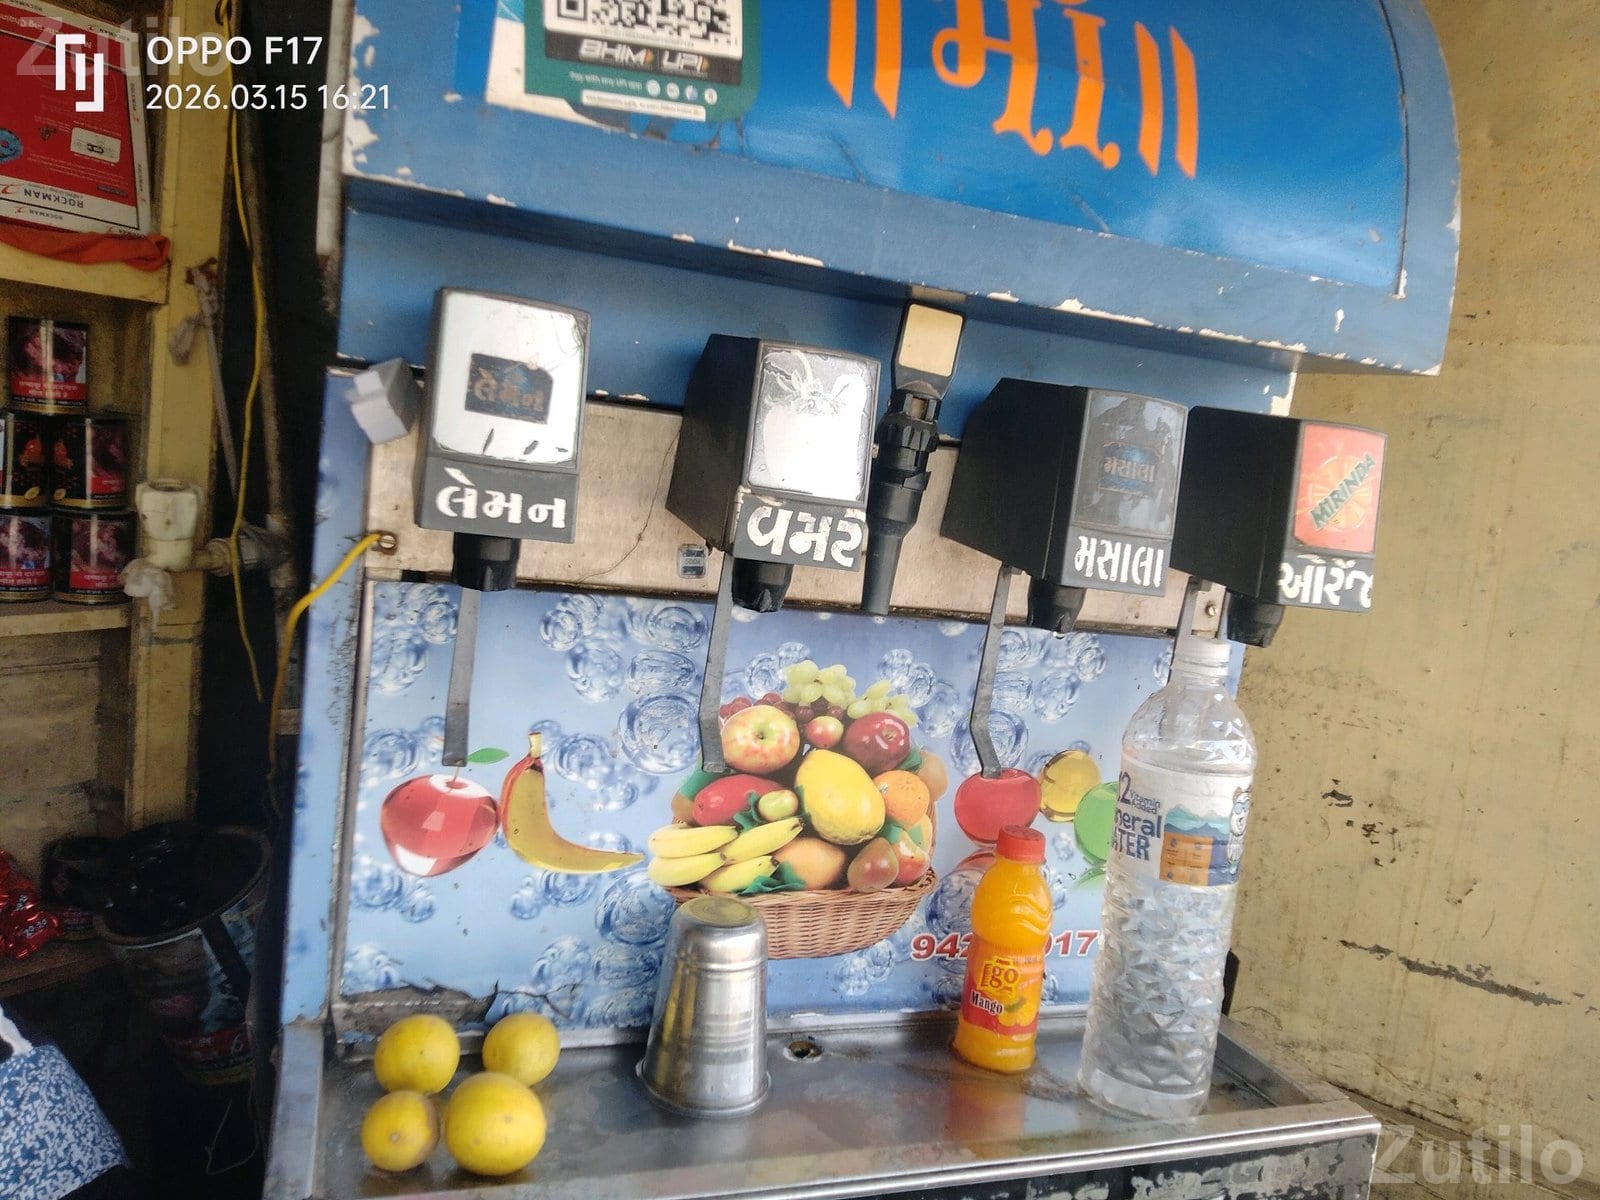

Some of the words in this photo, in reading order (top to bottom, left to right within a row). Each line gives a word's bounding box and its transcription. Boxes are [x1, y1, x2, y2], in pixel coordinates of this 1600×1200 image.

[579, 38, 648, 65] BHIM
[662, 50, 703, 73] UPI
[24, 187, 84, 209] ROCKMAN
[436, 466, 567, 529] લેમન
[1310, 452, 1376, 529] MIRINDA
[1074, 535, 1164, 588] મસાલા
[1114, 808, 1162, 839] neral
[971, 991, 1003, 1014] Mango
